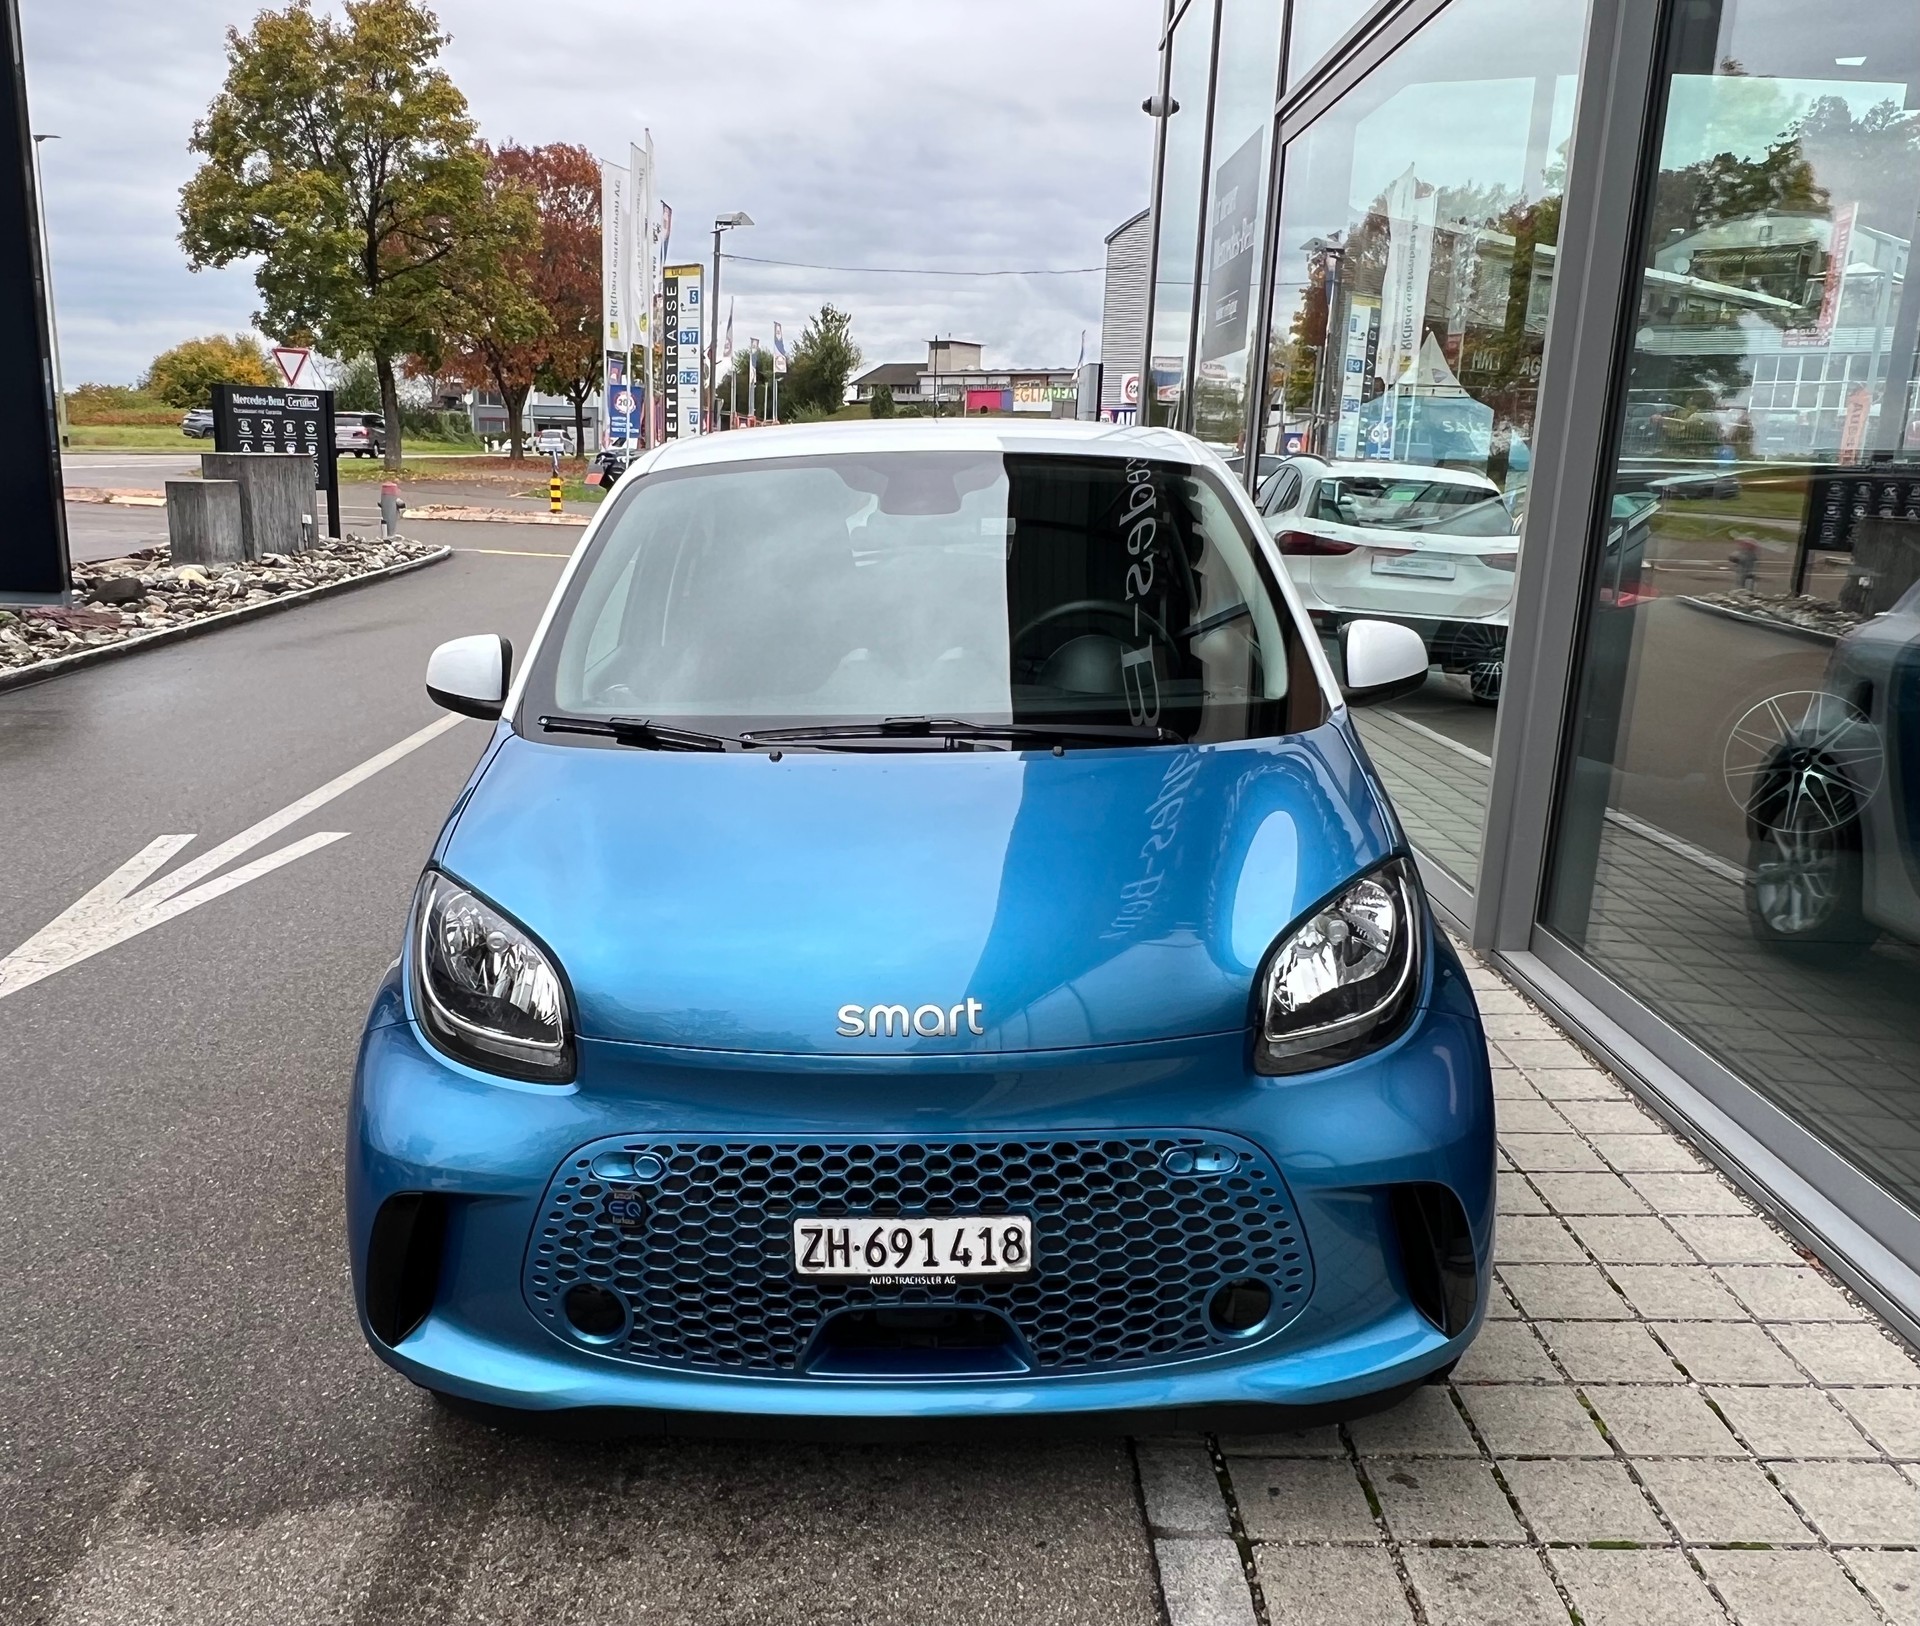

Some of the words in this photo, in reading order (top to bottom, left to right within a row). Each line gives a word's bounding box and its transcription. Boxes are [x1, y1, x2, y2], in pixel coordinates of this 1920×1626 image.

[691, 291, 697, 303] 5
[232, 393, 285, 407] Mercedes-Benz
[287, 396, 317, 408] Certified
[836, 997, 984, 1037] smart
[608, 1200, 641, 1217] EQ
[944, 1276, 956, 1285] AG
